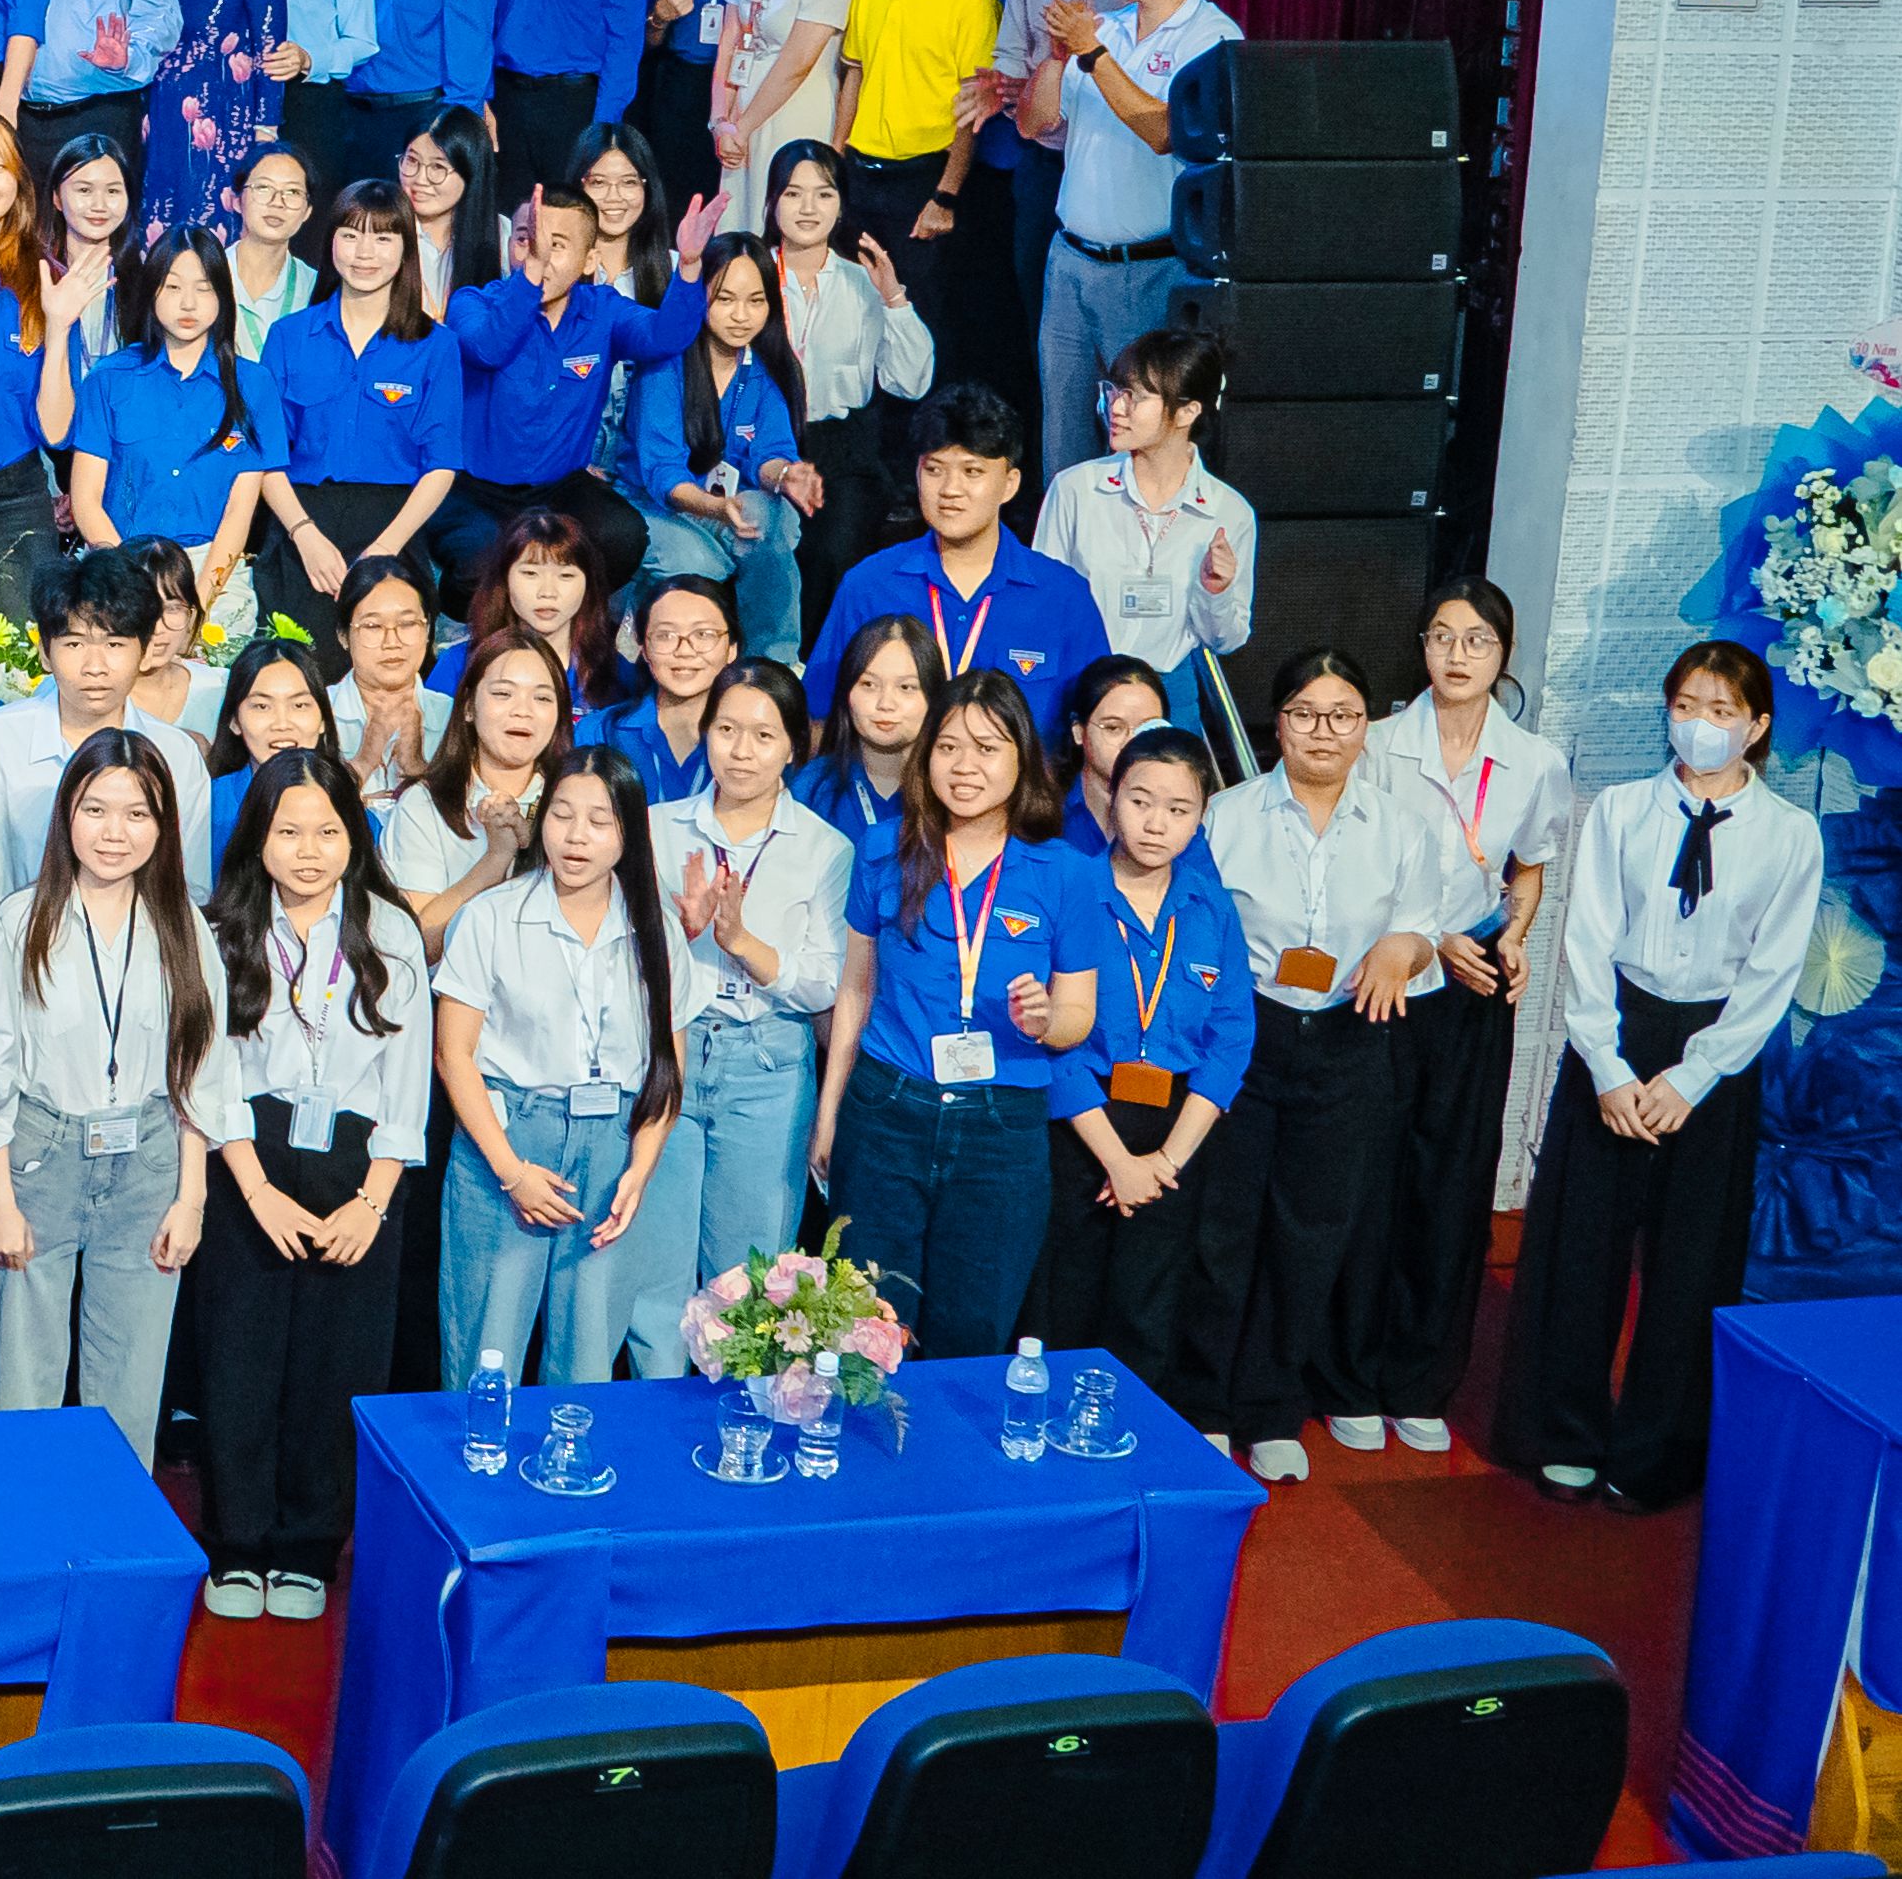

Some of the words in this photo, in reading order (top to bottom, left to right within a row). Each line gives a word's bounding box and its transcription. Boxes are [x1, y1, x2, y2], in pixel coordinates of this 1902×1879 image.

[1472, 1697, 1499, 1717] 5
[1054, 1735, 1080, 1752] 6
[607, 1766, 635, 1785] 7
